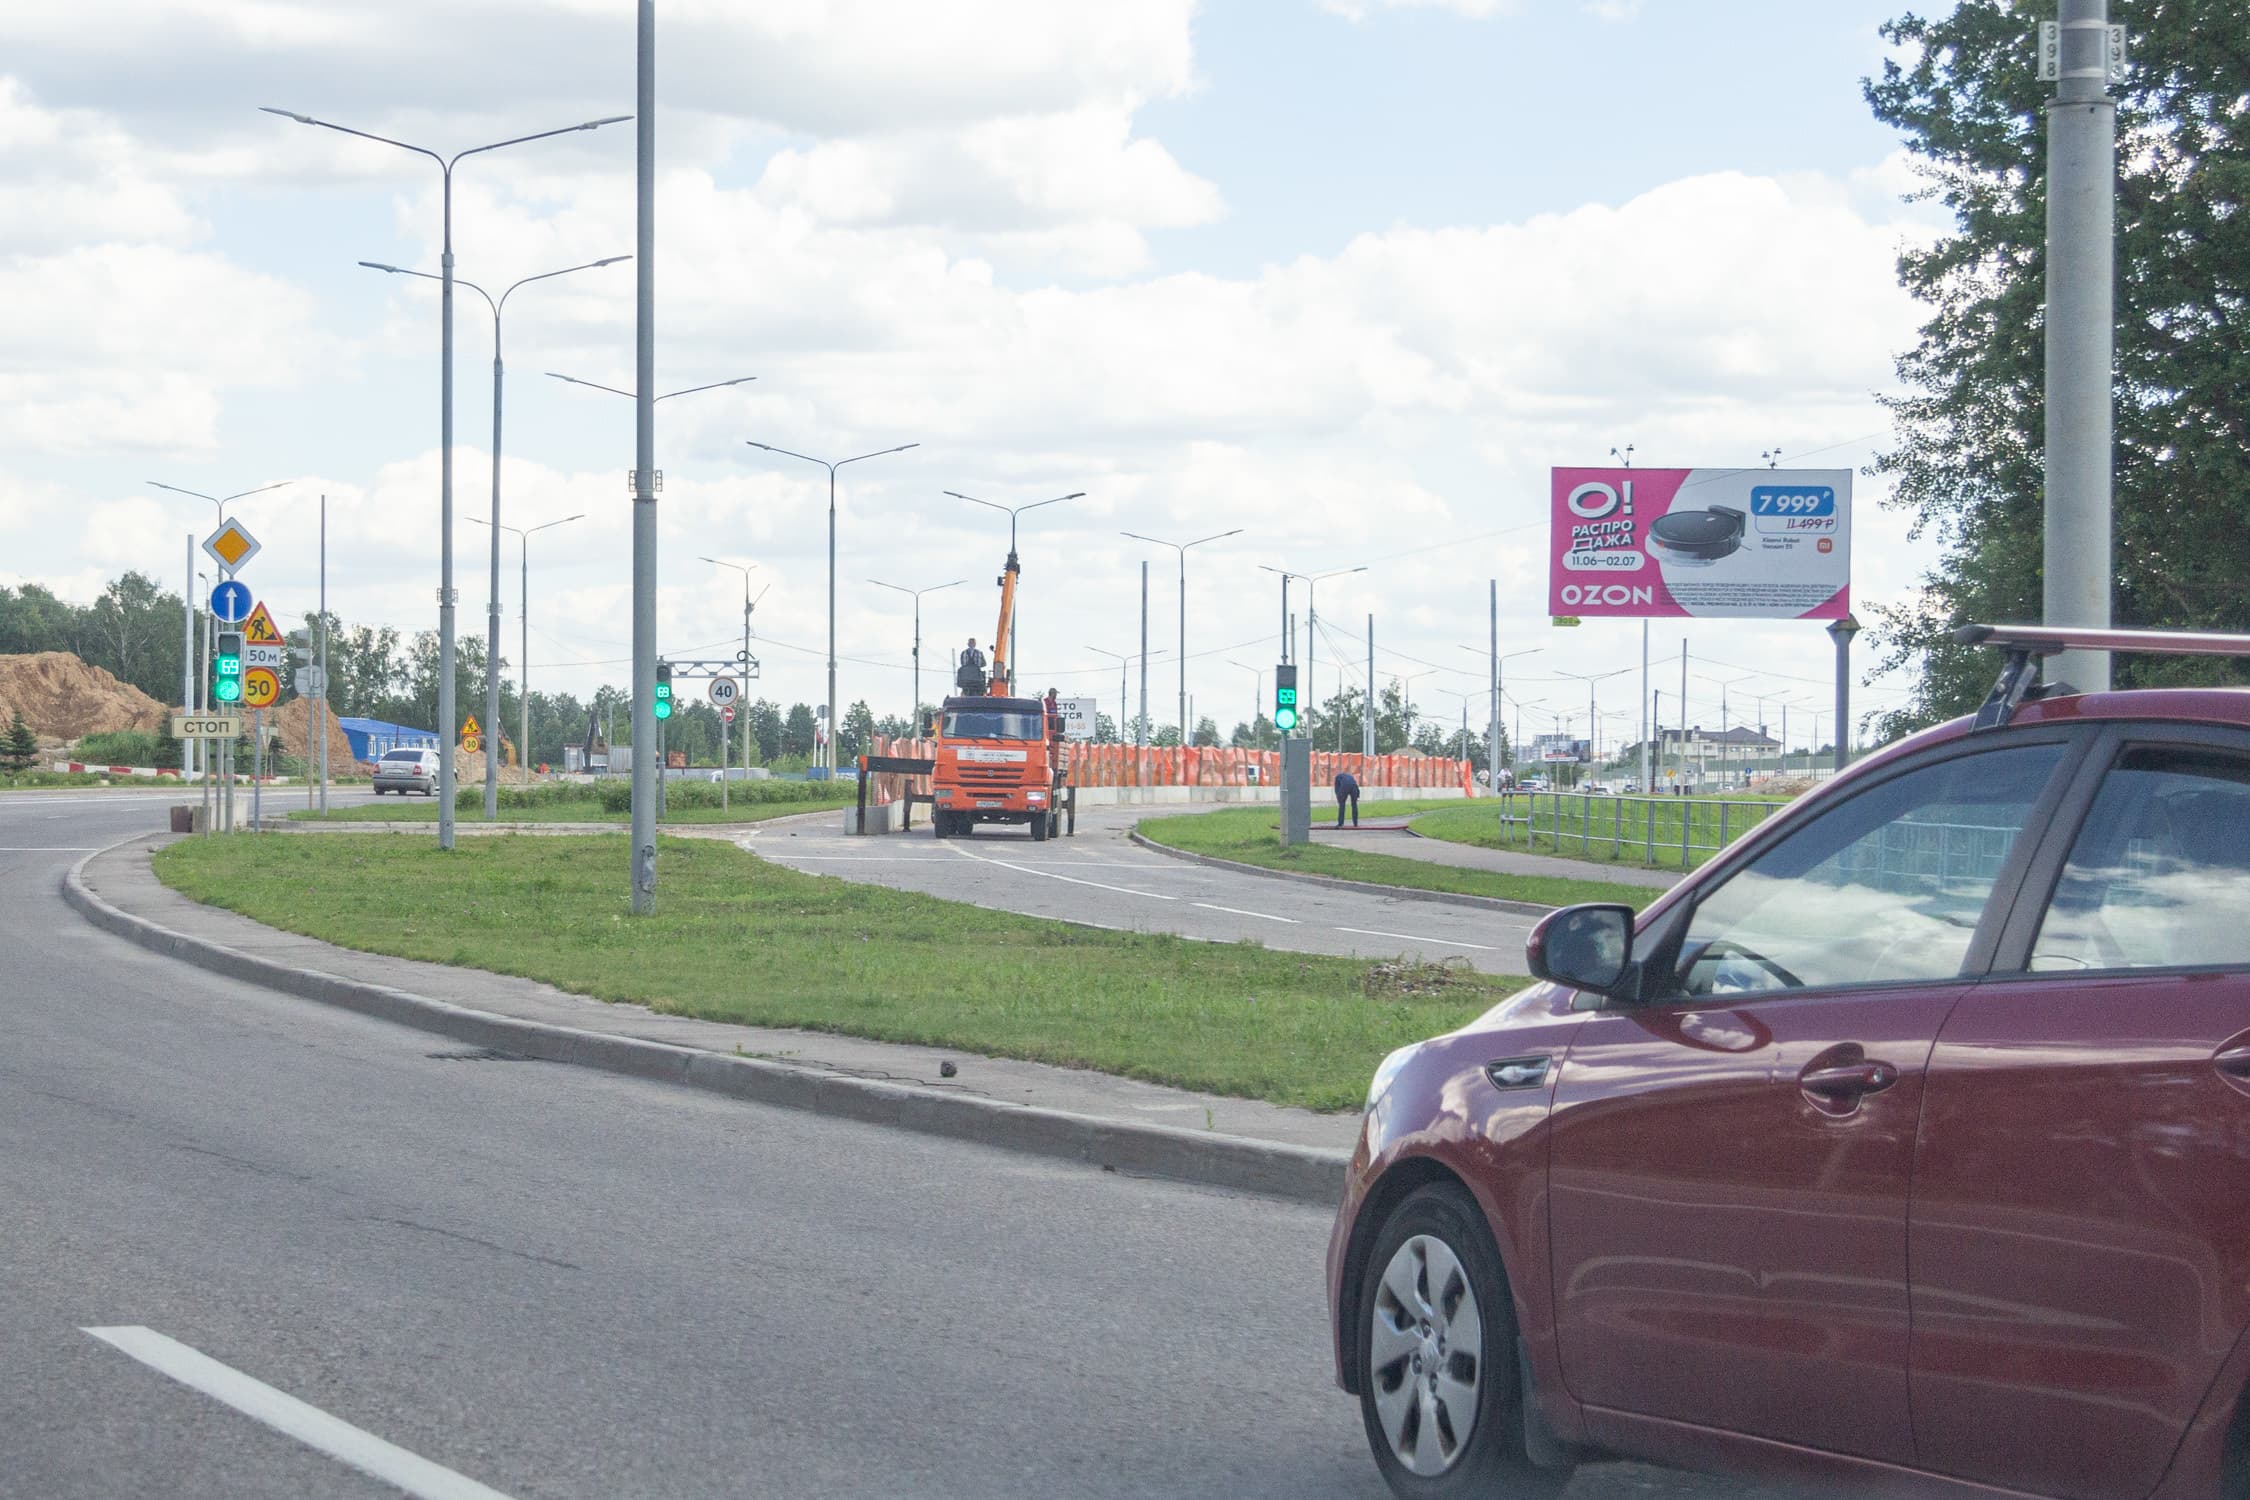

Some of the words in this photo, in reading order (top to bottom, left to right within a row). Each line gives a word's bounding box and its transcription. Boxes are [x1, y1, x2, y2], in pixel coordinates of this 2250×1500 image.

[2047, 25, 2057, 77] 398
[1567, 480, 1634, 519] О!
[1758, 495, 1773, 512] 7
[1776, 495, 1820, 512] 999
[1571, 520, 1634, 537] РАСПРО
[1571, 533, 1633, 553] ДАЖА
[1561, 585, 1652, 606] OZON
[221, 659, 239, 675] 69
[247, 680, 270, 696] 50
[715, 685, 732, 698] 40
[1057, 702, 1076, 711] СТО
[184, 721, 230, 733] СТОП
[466, 740, 477, 748] 30
